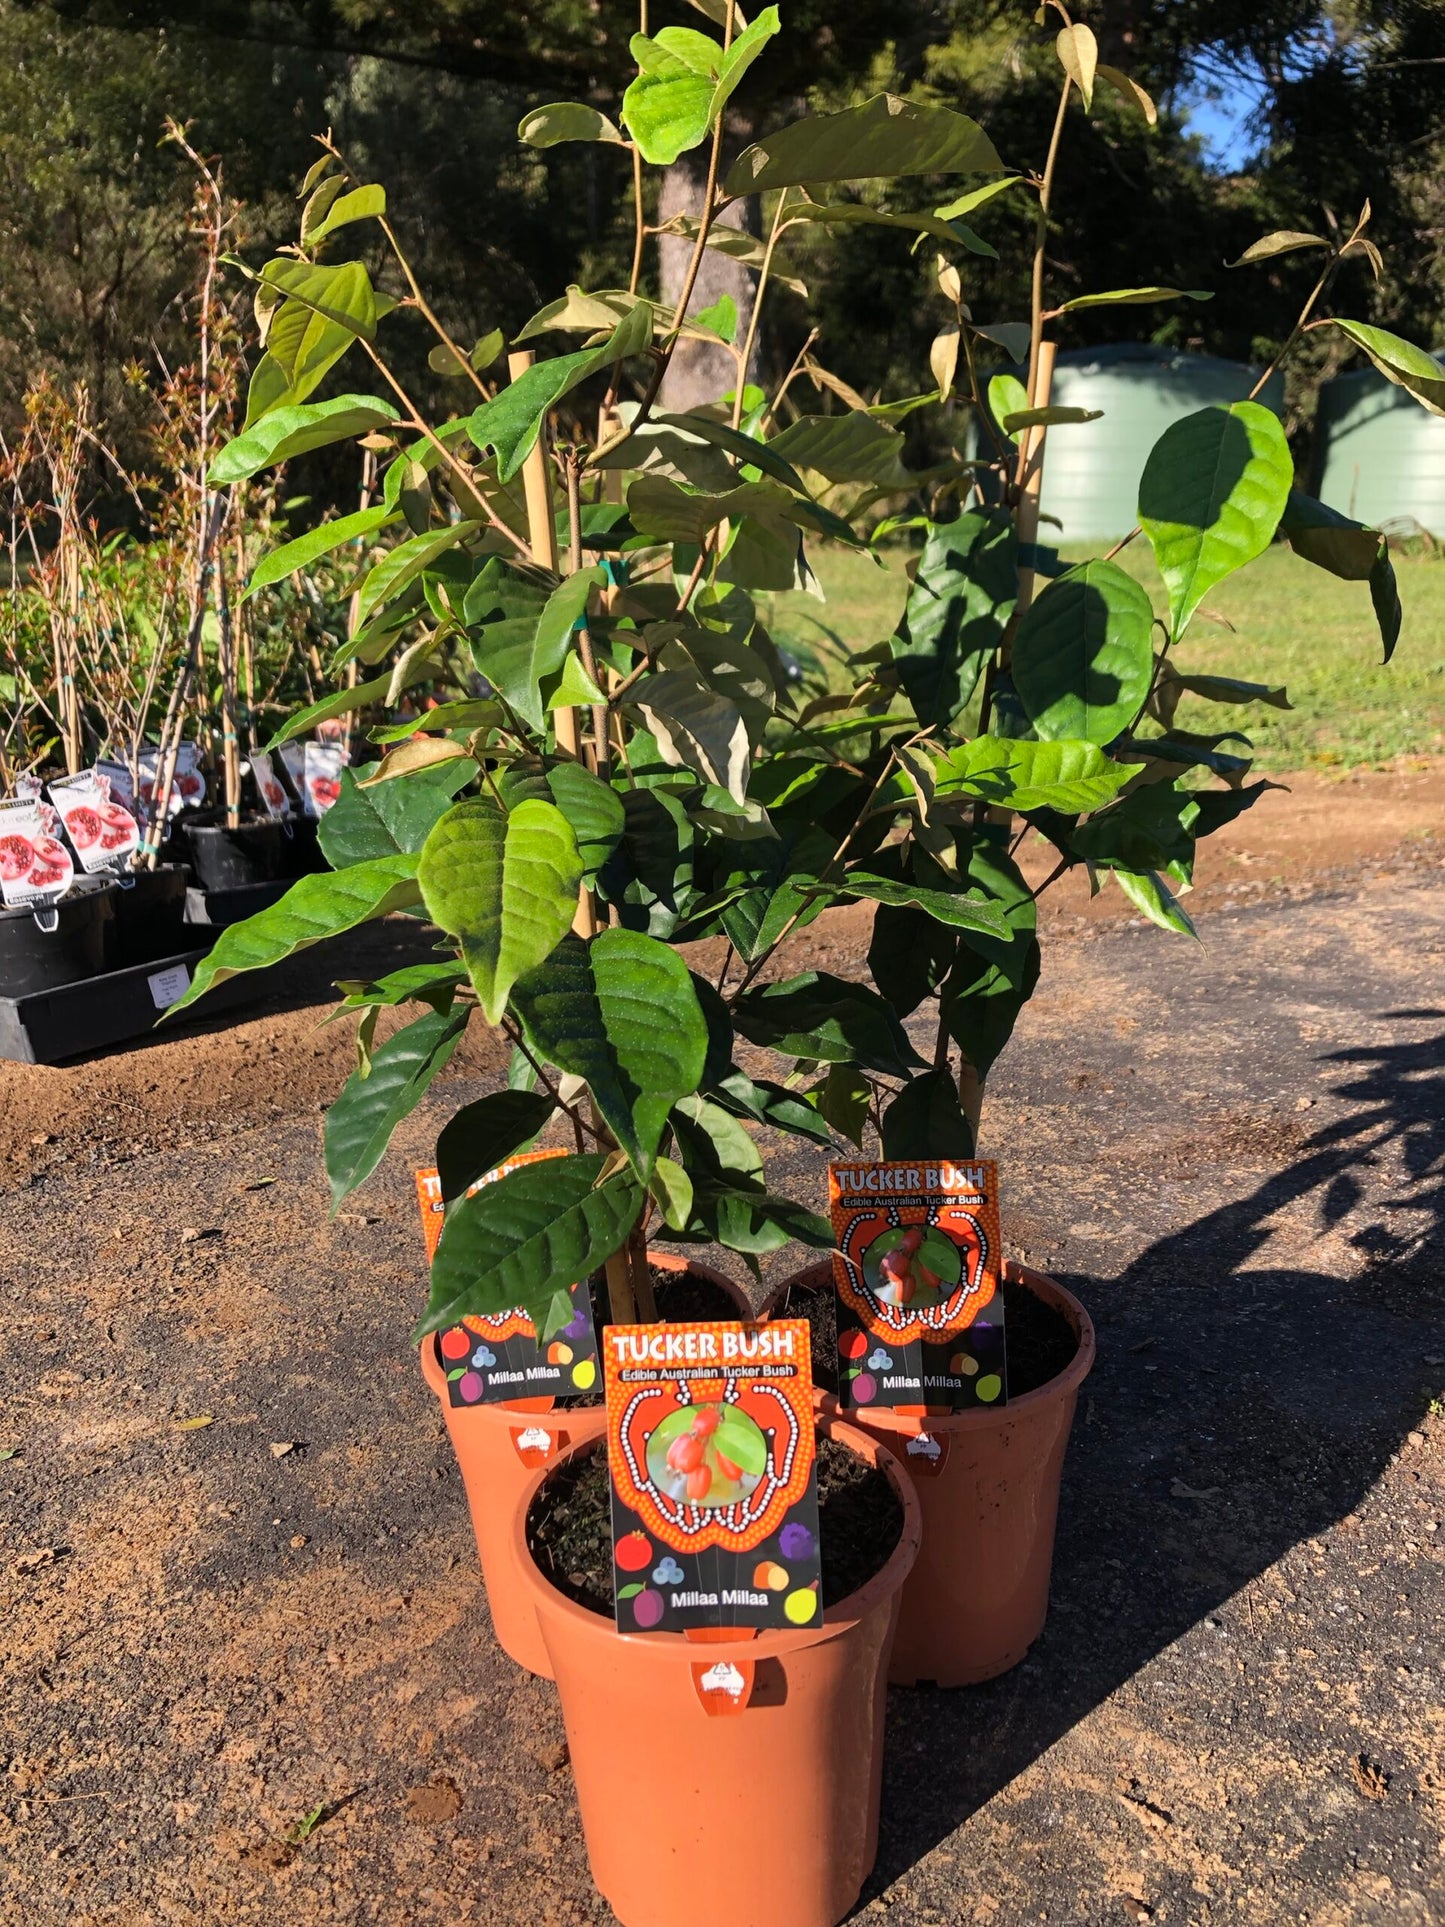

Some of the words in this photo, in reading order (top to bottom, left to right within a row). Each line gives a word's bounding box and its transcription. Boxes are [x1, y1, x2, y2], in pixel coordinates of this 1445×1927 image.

[836, 1168, 921, 1191] TUCKER
[926, 1167, 984, 1190] BUSH
[843, 1197, 872, 1207] Edible
[874, 1196, 922, 1206] Australian
[924, 1195, 956, 1205] Tucker
[958, 1194, 984, 1205] Bush
[612, 1332, 718, 1362] TUCKER
[722, 1330, 794, 1359] BUSH
[488, 1371, 525, 1385] Millaa
[526, 1367, 561, 1381] Millaa
[622, 1368, 657, 1381] Edible
[659, 1366, 718, 1380] Australian
[721, 1365, 760, 1378] Tucker
[763, 1364, 794, 1377] Bush
[883, 1376, 921, 1389] Millaa
[924, 1375, 962, 1388] Millaa
[671, 1590, 719, 1608] Millaa
[721, 1589, 769, 1606] Millaa
